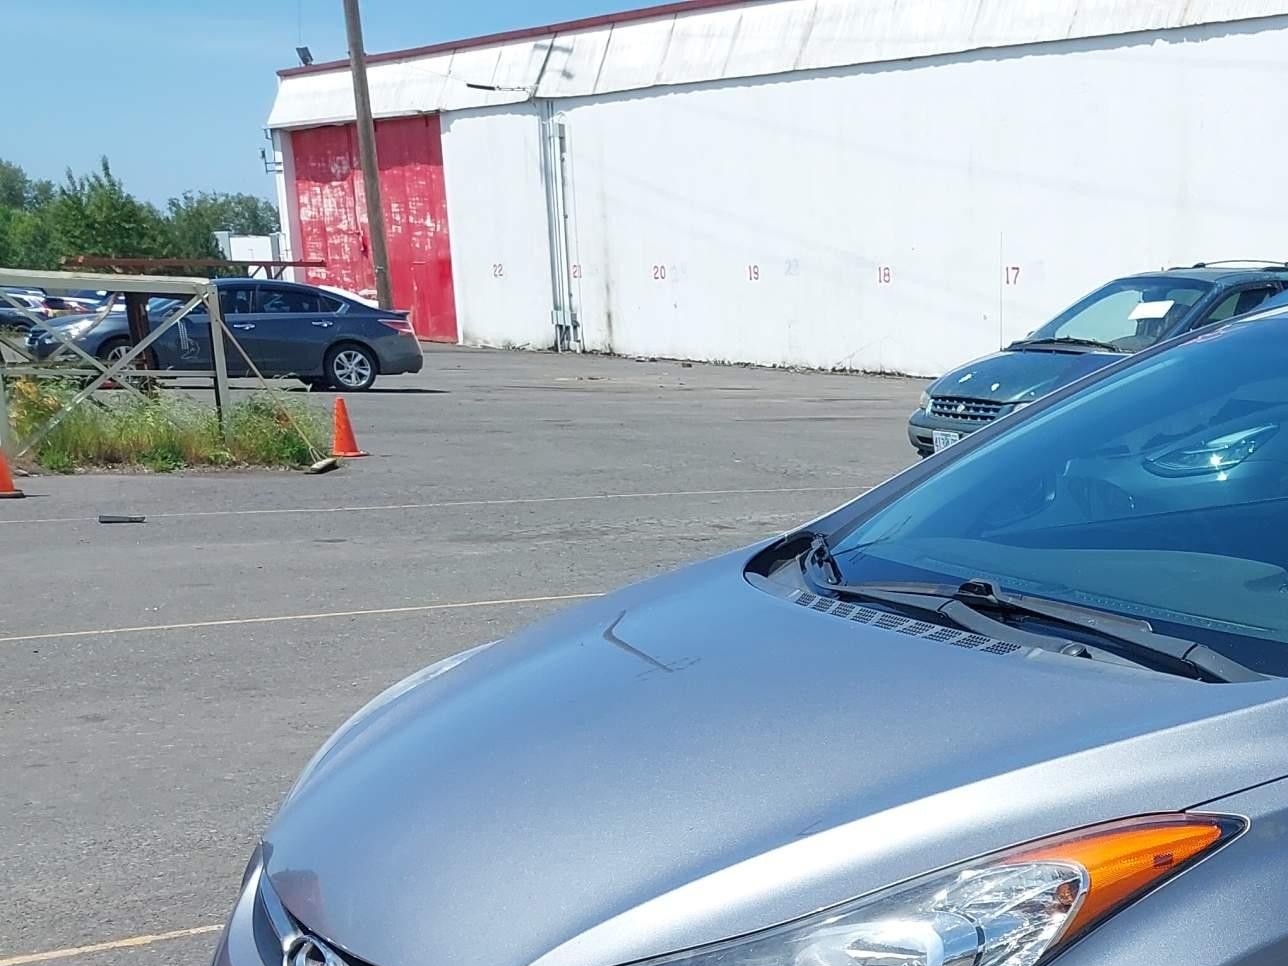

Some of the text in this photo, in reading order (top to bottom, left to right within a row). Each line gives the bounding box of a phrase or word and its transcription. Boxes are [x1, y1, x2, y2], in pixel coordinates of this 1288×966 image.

[493, 263, 504, 277] 22
[573, 264, 582, 278] 21
[653, 265, 666, 280] 20
[748, 264, 760, 280] 19
[878, 266, 891, 283] 18
[1005, 266, 1020, 285] 17
